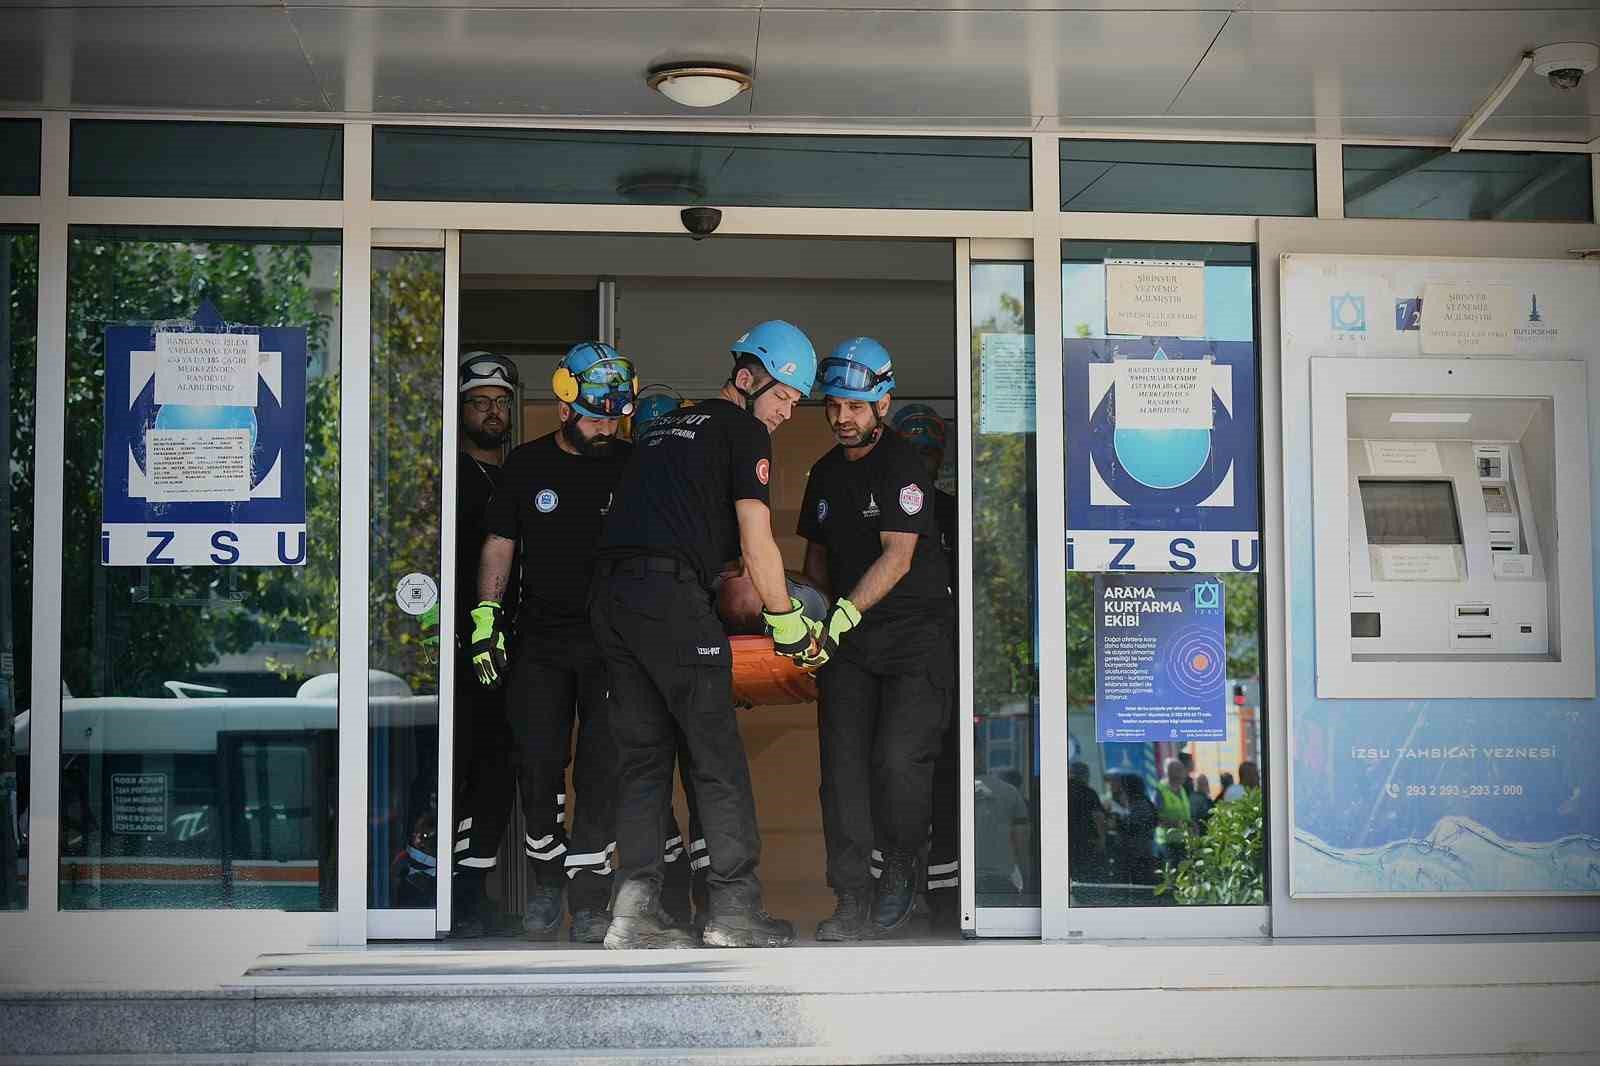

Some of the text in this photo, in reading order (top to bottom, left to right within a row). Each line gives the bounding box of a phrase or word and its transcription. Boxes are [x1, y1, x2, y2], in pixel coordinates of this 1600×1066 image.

[1104, 587, 1155, 599] ARAMA
[1104, 601, 1183, 613] KURTARMA
[1104, 612, 1140, 627] EKİBİ
[1485, 745, 1557, 759] VEZNESİ
[1429, 785, 1436, 795] 2
[1493, 785, 1500, 795] 2
